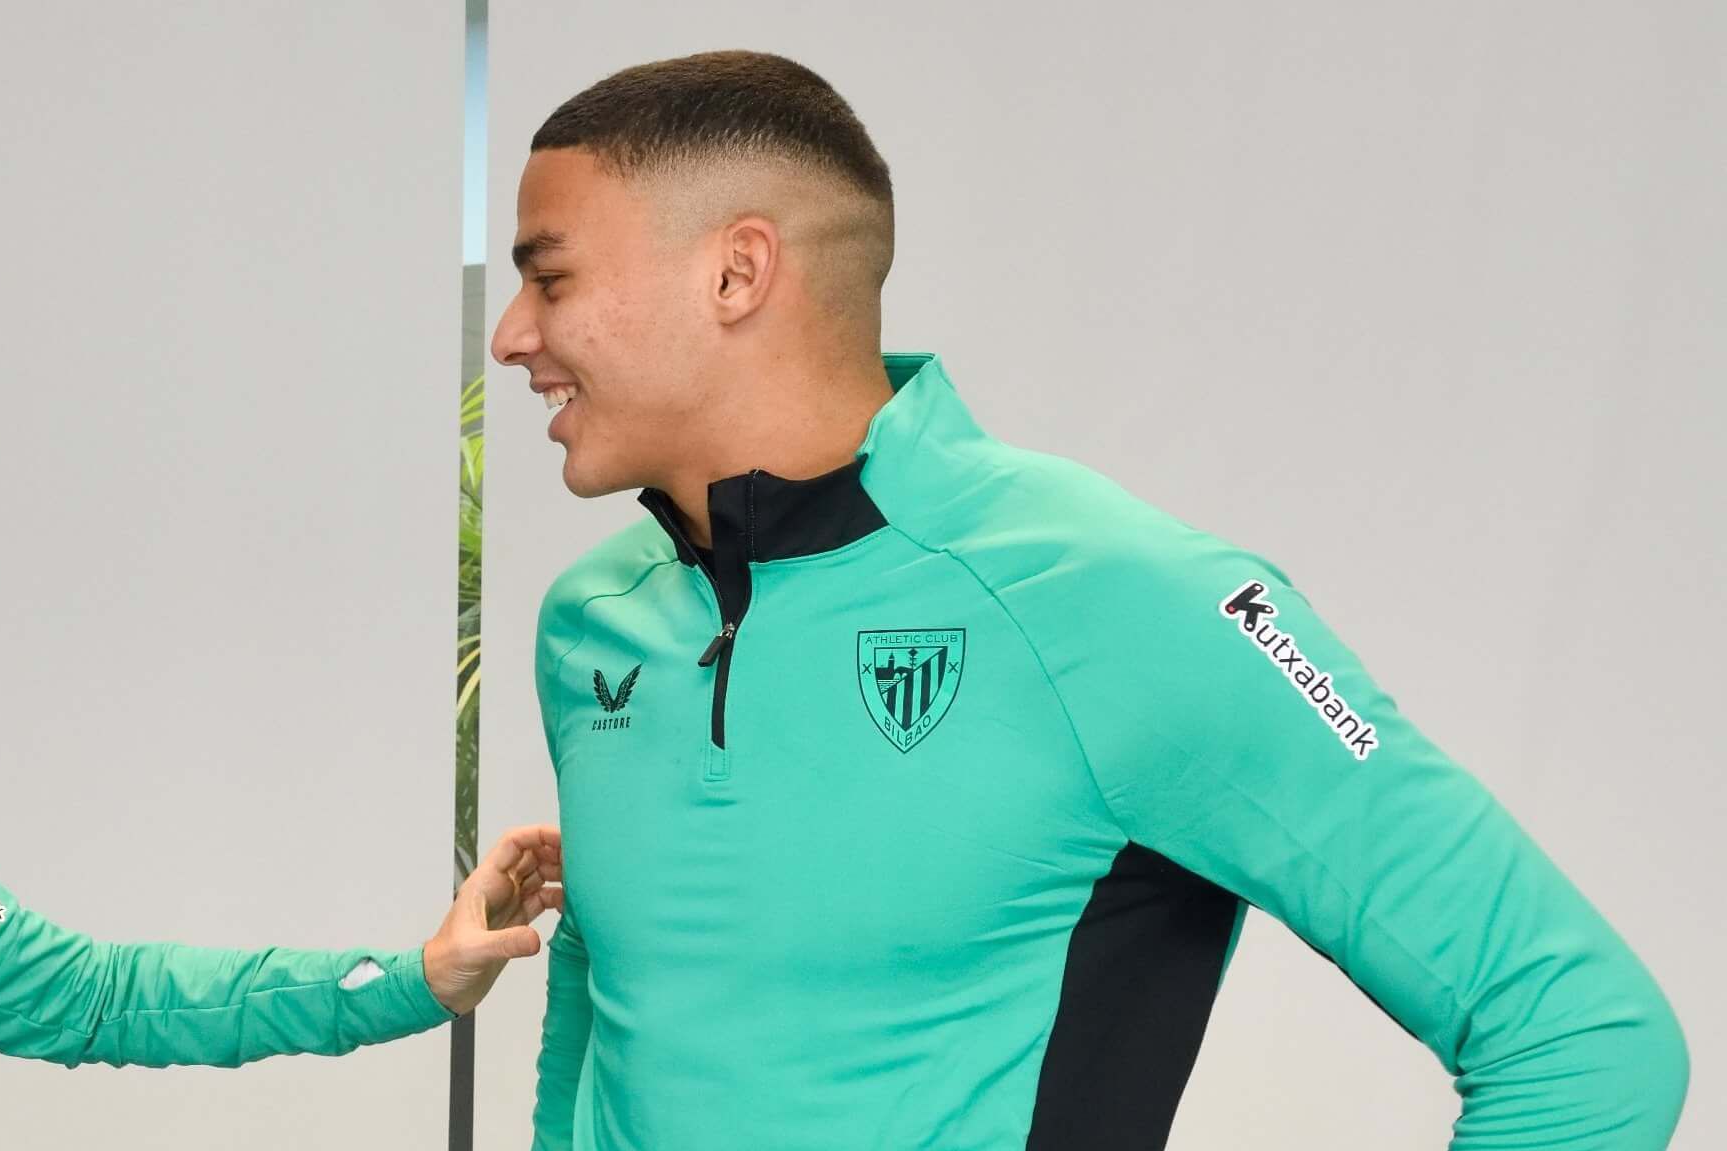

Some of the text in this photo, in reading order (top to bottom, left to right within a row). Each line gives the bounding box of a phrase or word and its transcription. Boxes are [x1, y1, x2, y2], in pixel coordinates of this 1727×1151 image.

[864, 634, 958, 645] ATHLETIC CLUB
[1224, 582, 1375, 756] Kutxabank
[591, 716, 631, 731] CASTORE
[883, 714, 931, 748] BILBAO
